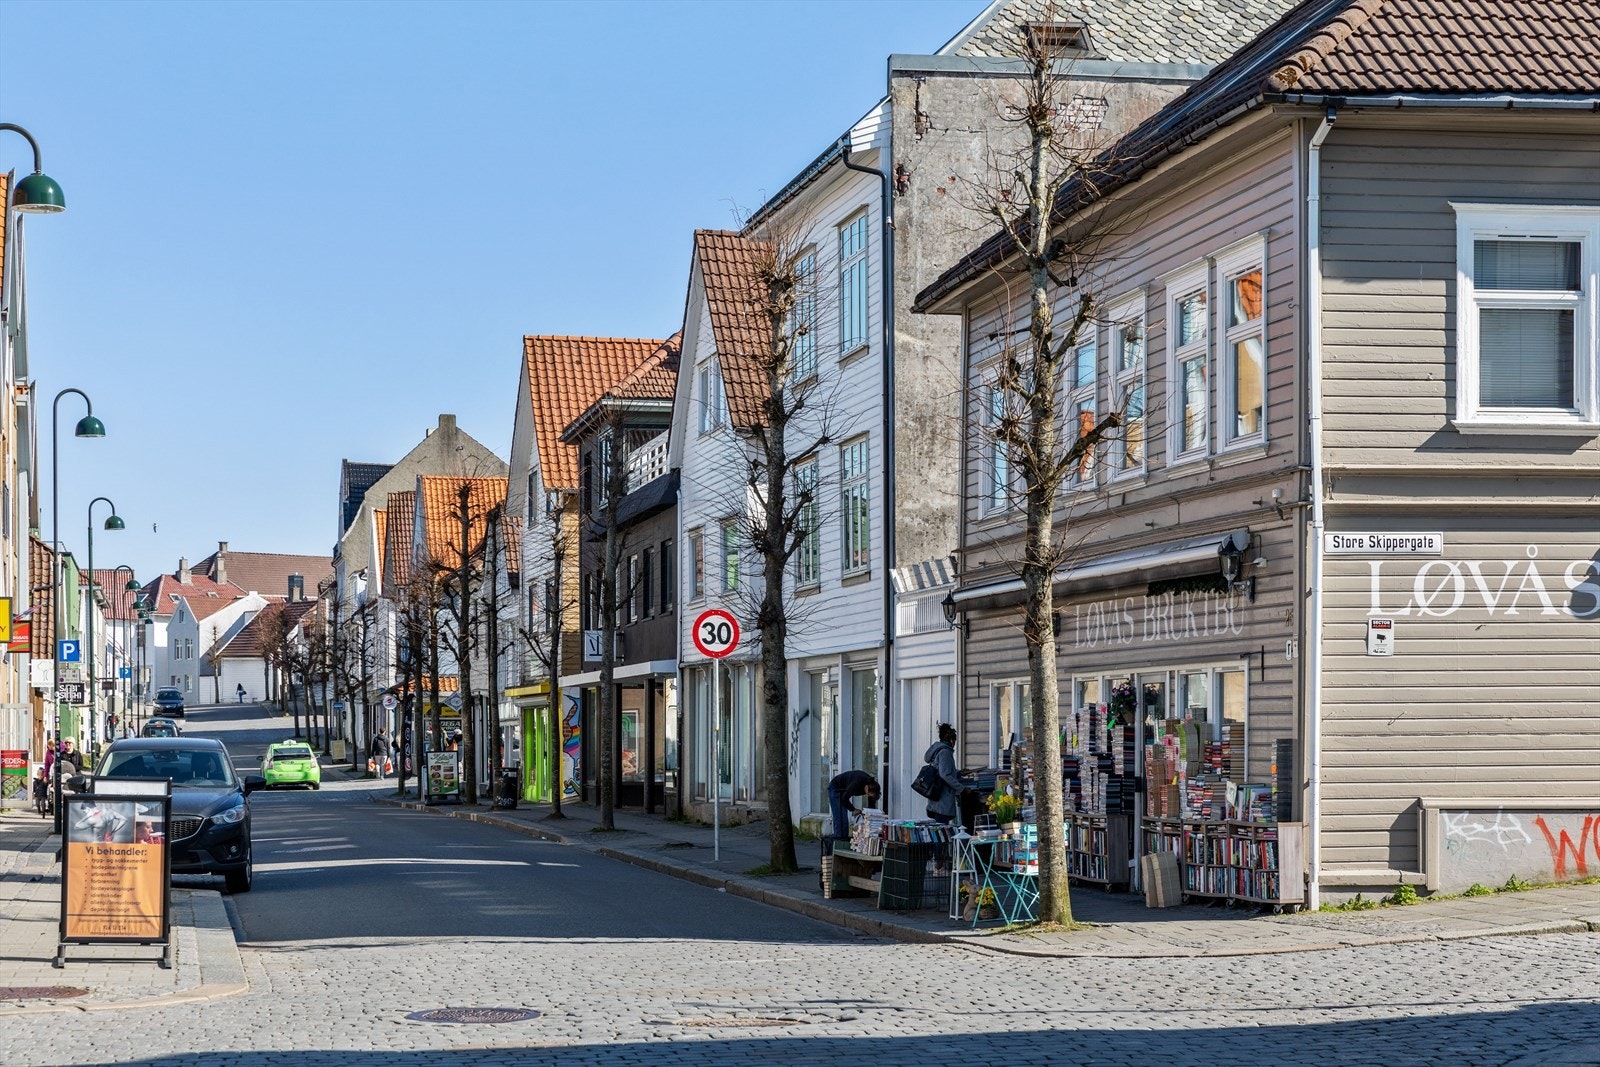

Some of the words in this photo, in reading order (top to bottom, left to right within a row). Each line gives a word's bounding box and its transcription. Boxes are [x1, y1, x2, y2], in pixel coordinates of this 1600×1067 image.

[1333, 535, 1364, 548] Store
[1369, 535, 1434, 551] Skippergate
[1366, 545, 1600, 618] LØVÅS
[701, 621, 732, 645] 30
[63, 643, 75, 660] P
[86, 846, 94, 855] Vi
[97, 847, 148, 856] behandler:
[1532, 813, 1600, 879] W
